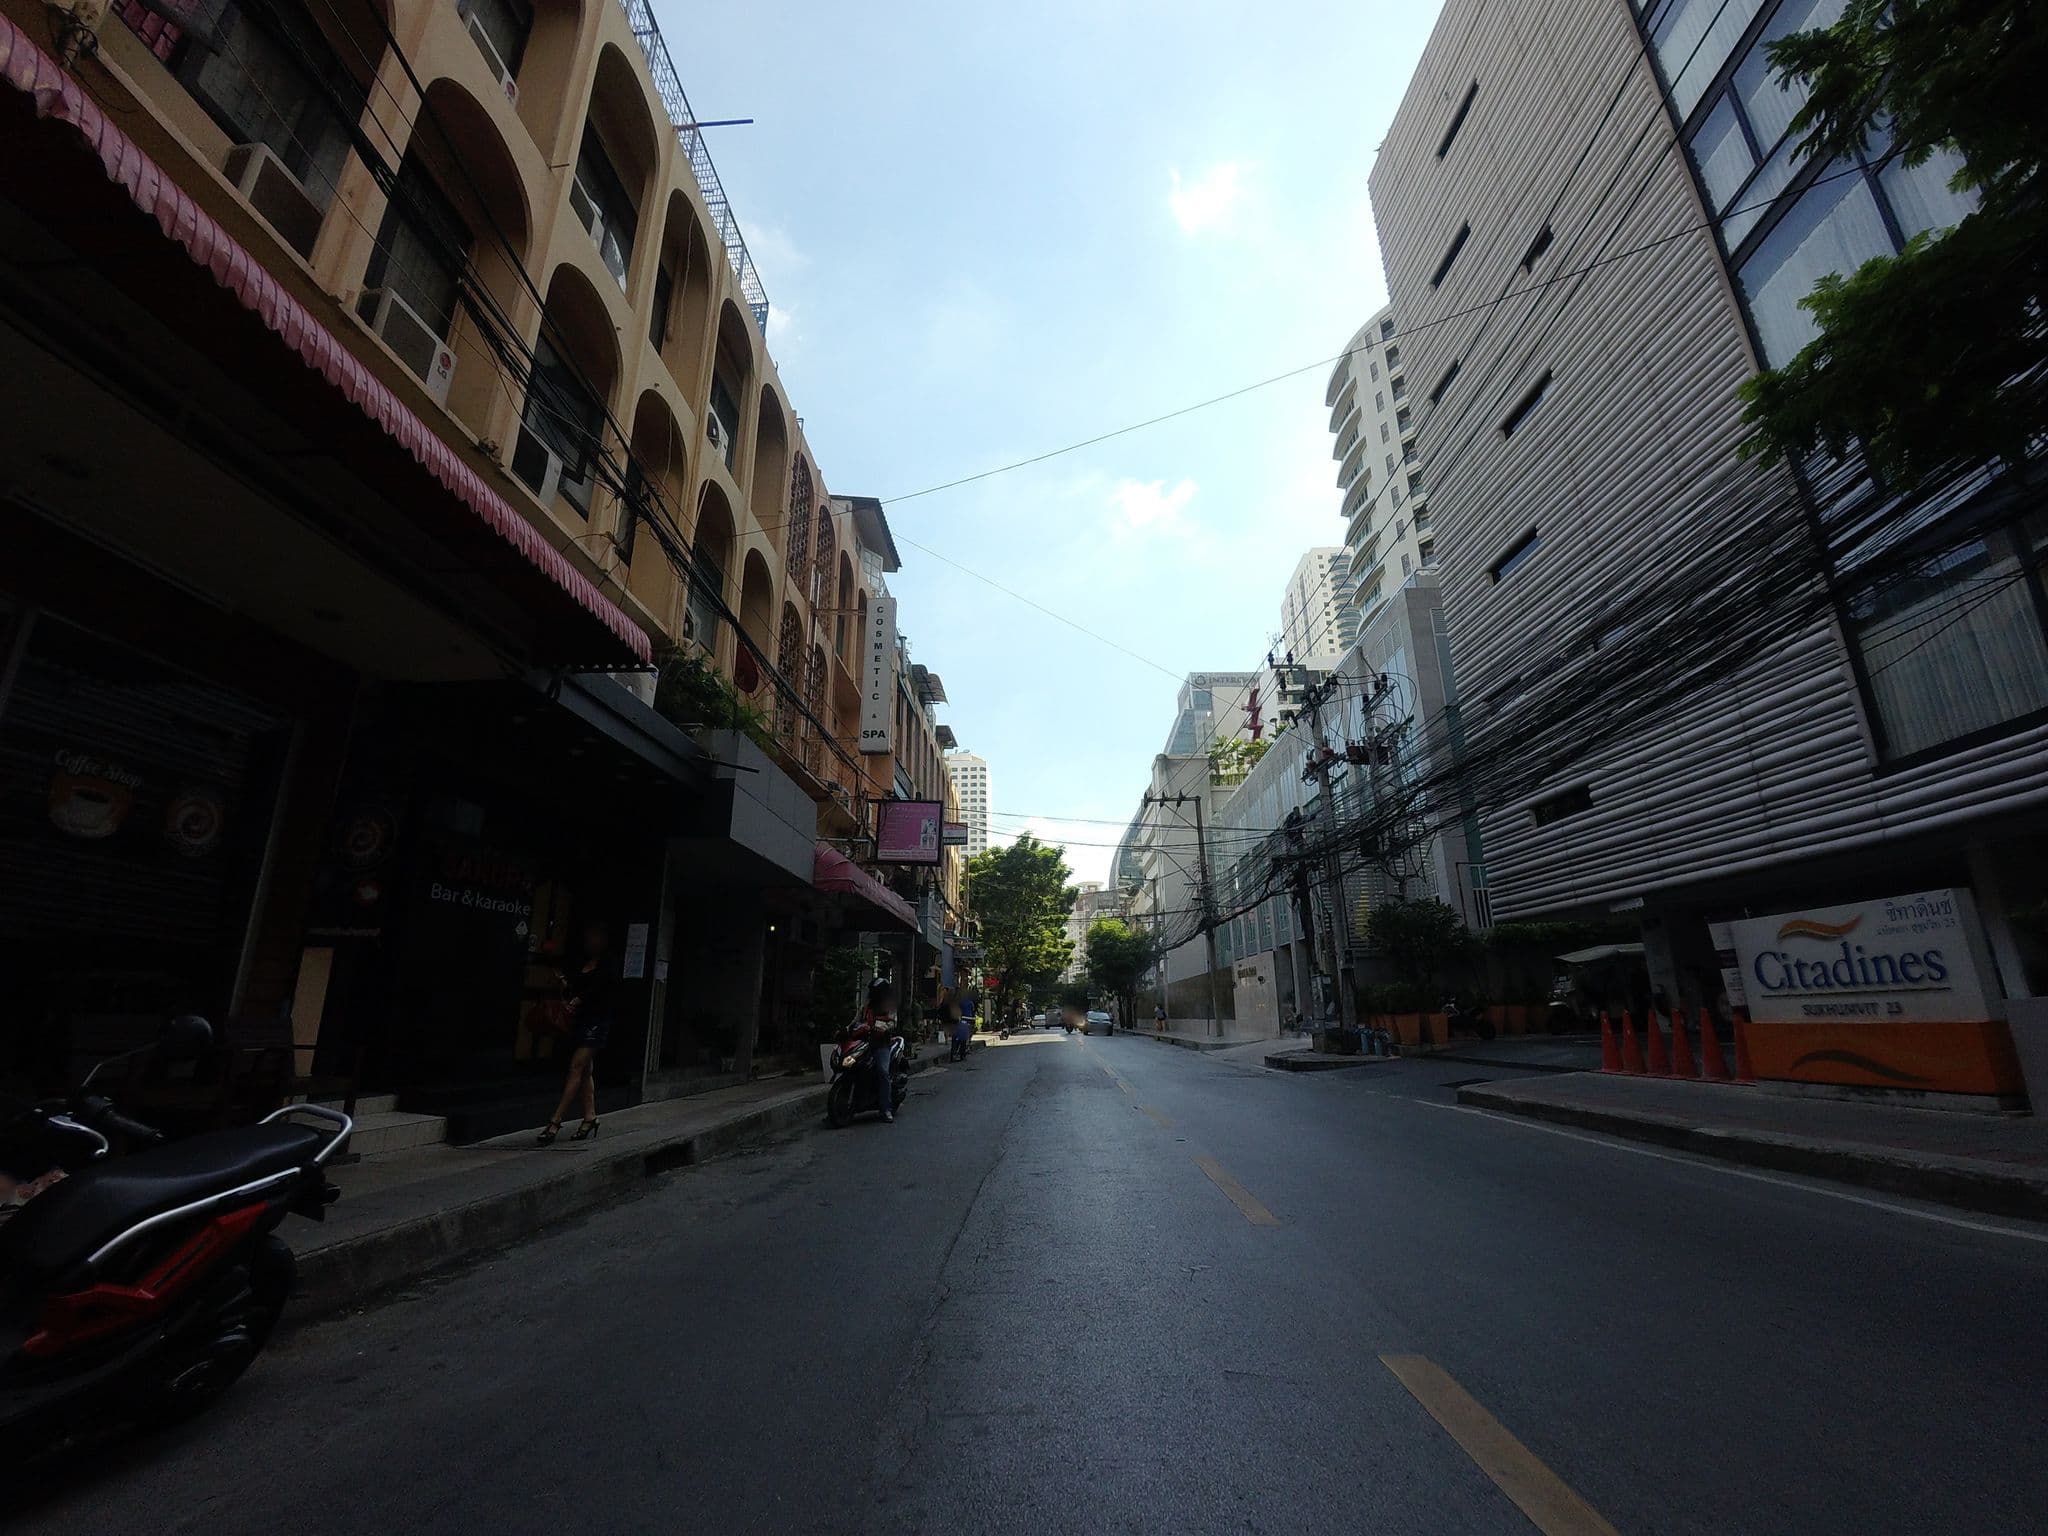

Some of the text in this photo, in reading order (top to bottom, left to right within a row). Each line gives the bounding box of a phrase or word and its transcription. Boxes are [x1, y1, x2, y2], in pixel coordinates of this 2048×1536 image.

[871, 606, 883, 701] COSMETIC
[862, 729, 886, 739] SPA
[54, 748, 99, 776] Coffee
[431, 882, 531, 916] Bar & karaoke
[1754, 941, 1948, 991] Citadines
